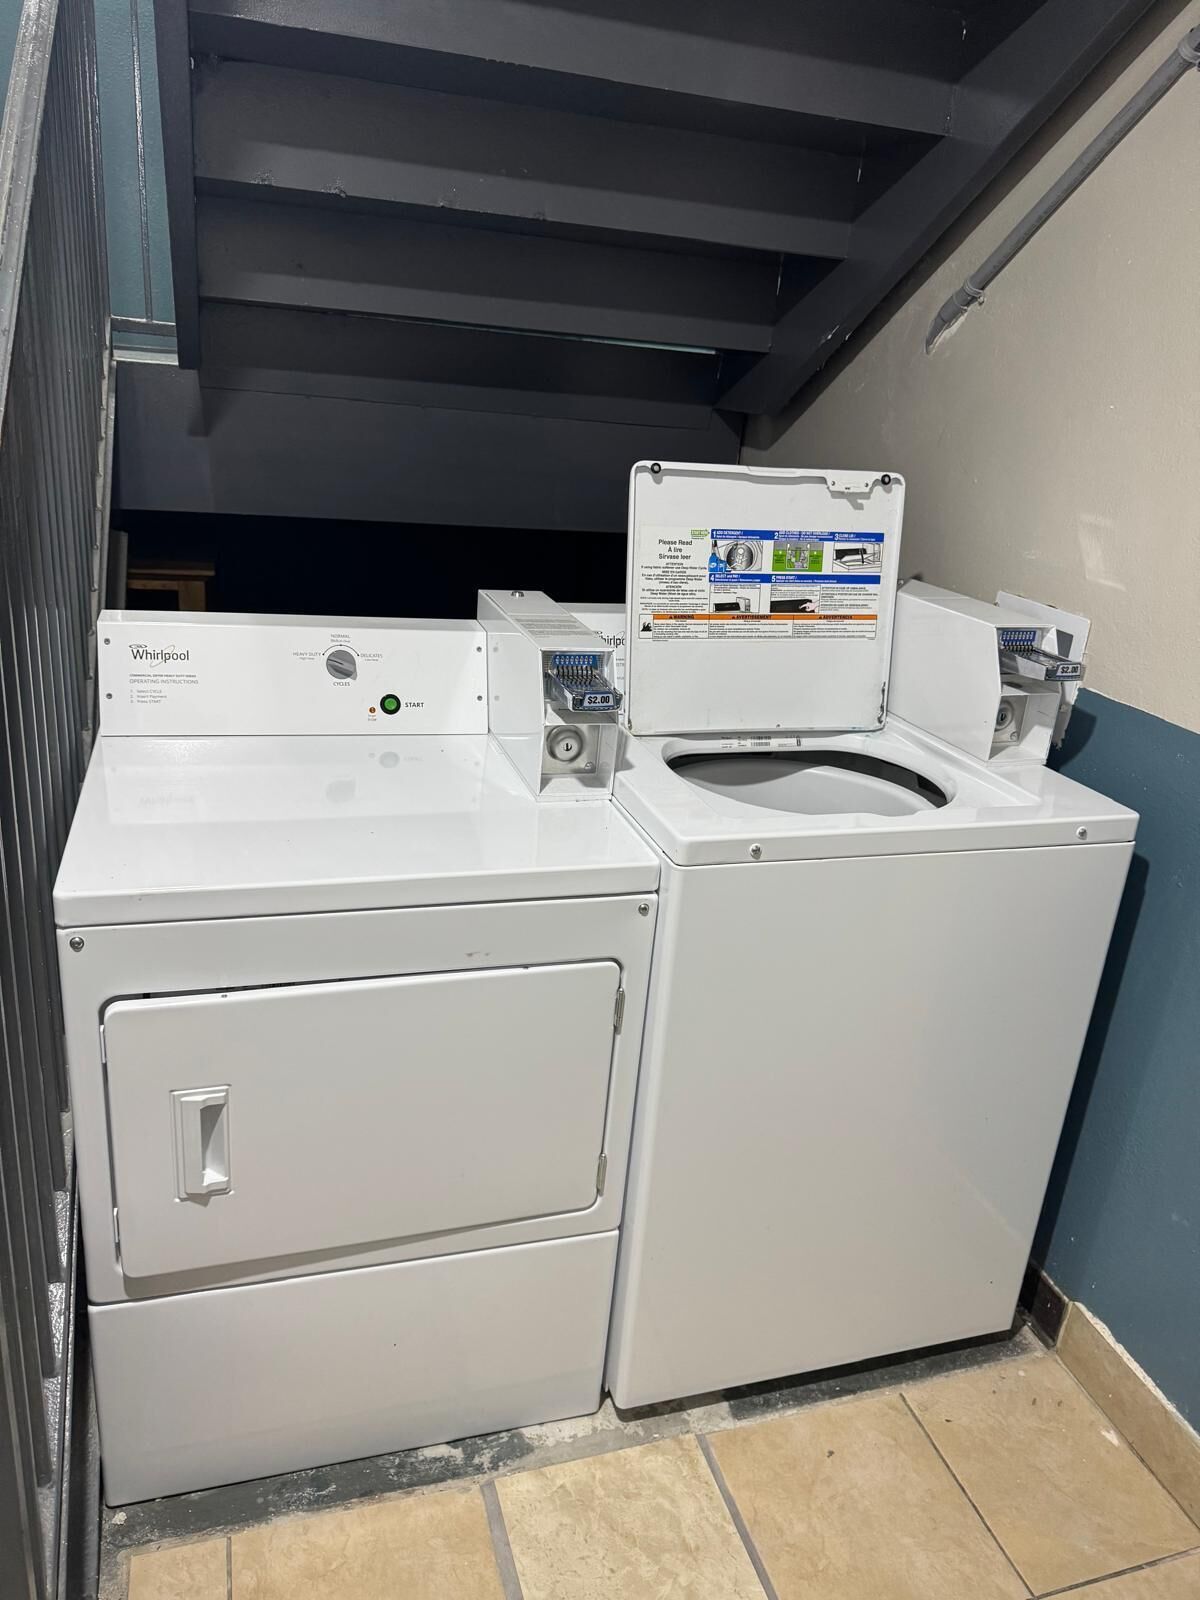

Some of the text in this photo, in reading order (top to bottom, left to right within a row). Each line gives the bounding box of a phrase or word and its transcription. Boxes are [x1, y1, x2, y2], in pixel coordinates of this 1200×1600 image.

[131, 649, 189, 663] Whirlpool
[1061, 666, 1079, 674] $2.00
[587, 695, 610, 705] $2.00
